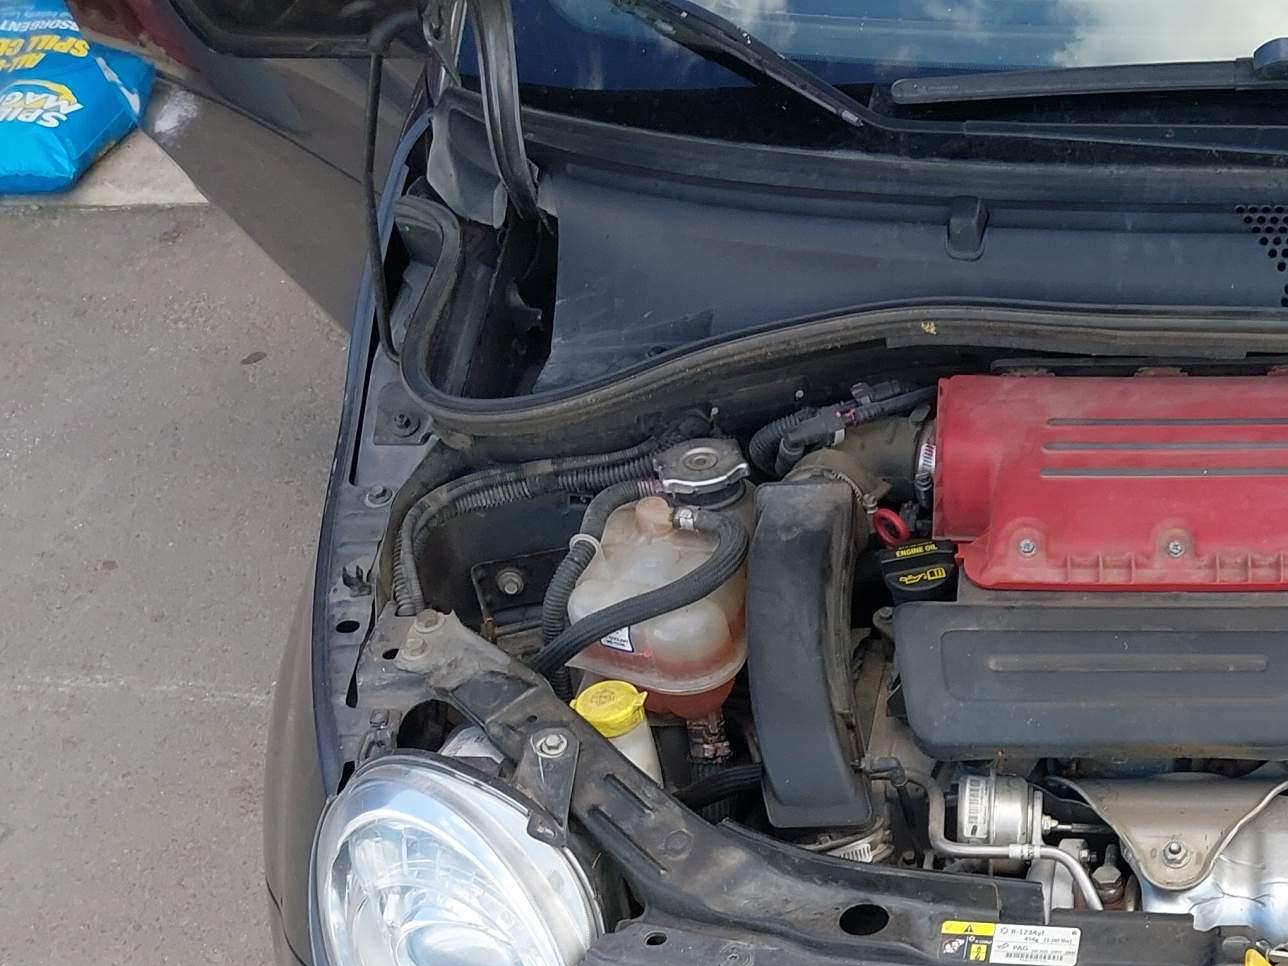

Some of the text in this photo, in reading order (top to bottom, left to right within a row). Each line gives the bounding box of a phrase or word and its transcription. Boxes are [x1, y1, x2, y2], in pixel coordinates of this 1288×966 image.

[28, 35, 90, 57] SPILL
[0, 91, 84, 114] MAG
[895, 545, 924, 557] ENGINE
[925, 543, 939, 552] OIL
